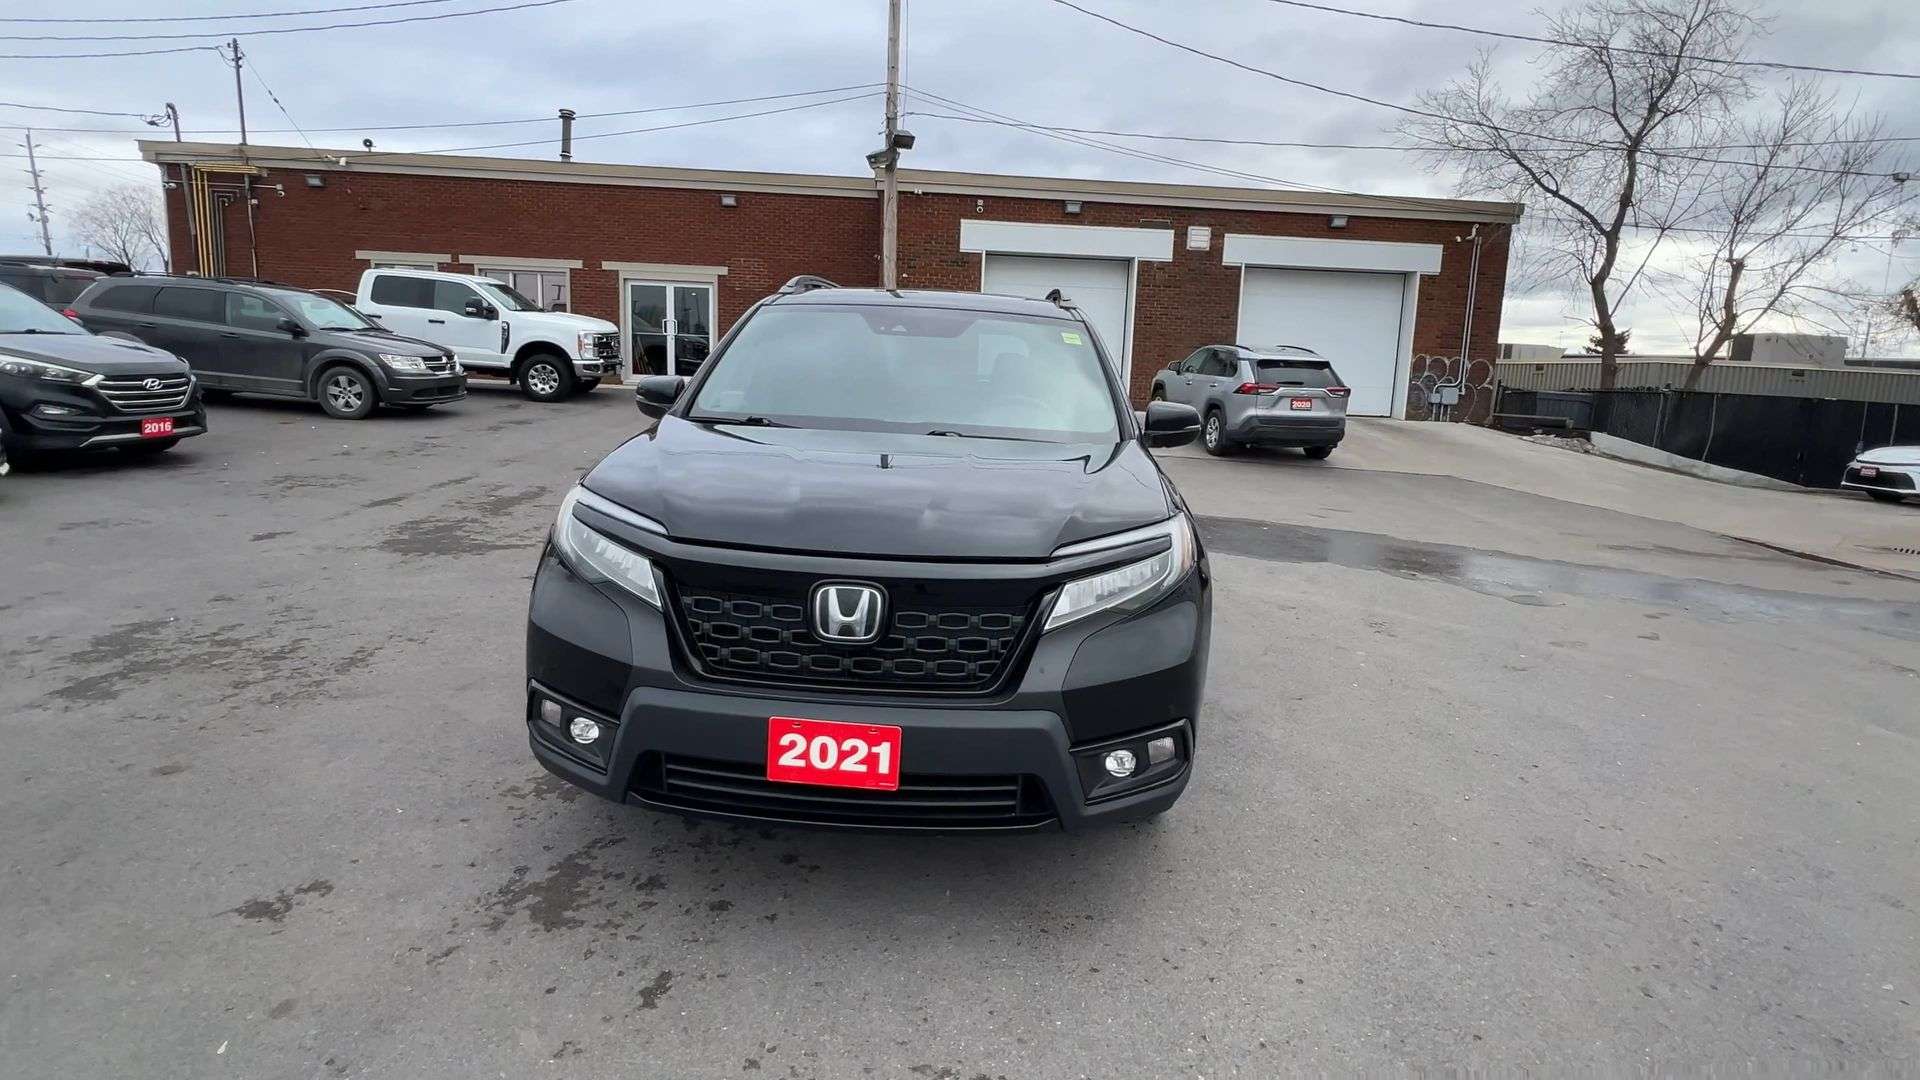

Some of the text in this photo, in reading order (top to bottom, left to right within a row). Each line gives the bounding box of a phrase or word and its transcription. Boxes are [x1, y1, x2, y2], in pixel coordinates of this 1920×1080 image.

[1291, 400, 1311, 409] 2020
[144, 421, 172, 433] 2016
[777, 732, 892, 775] 2021
